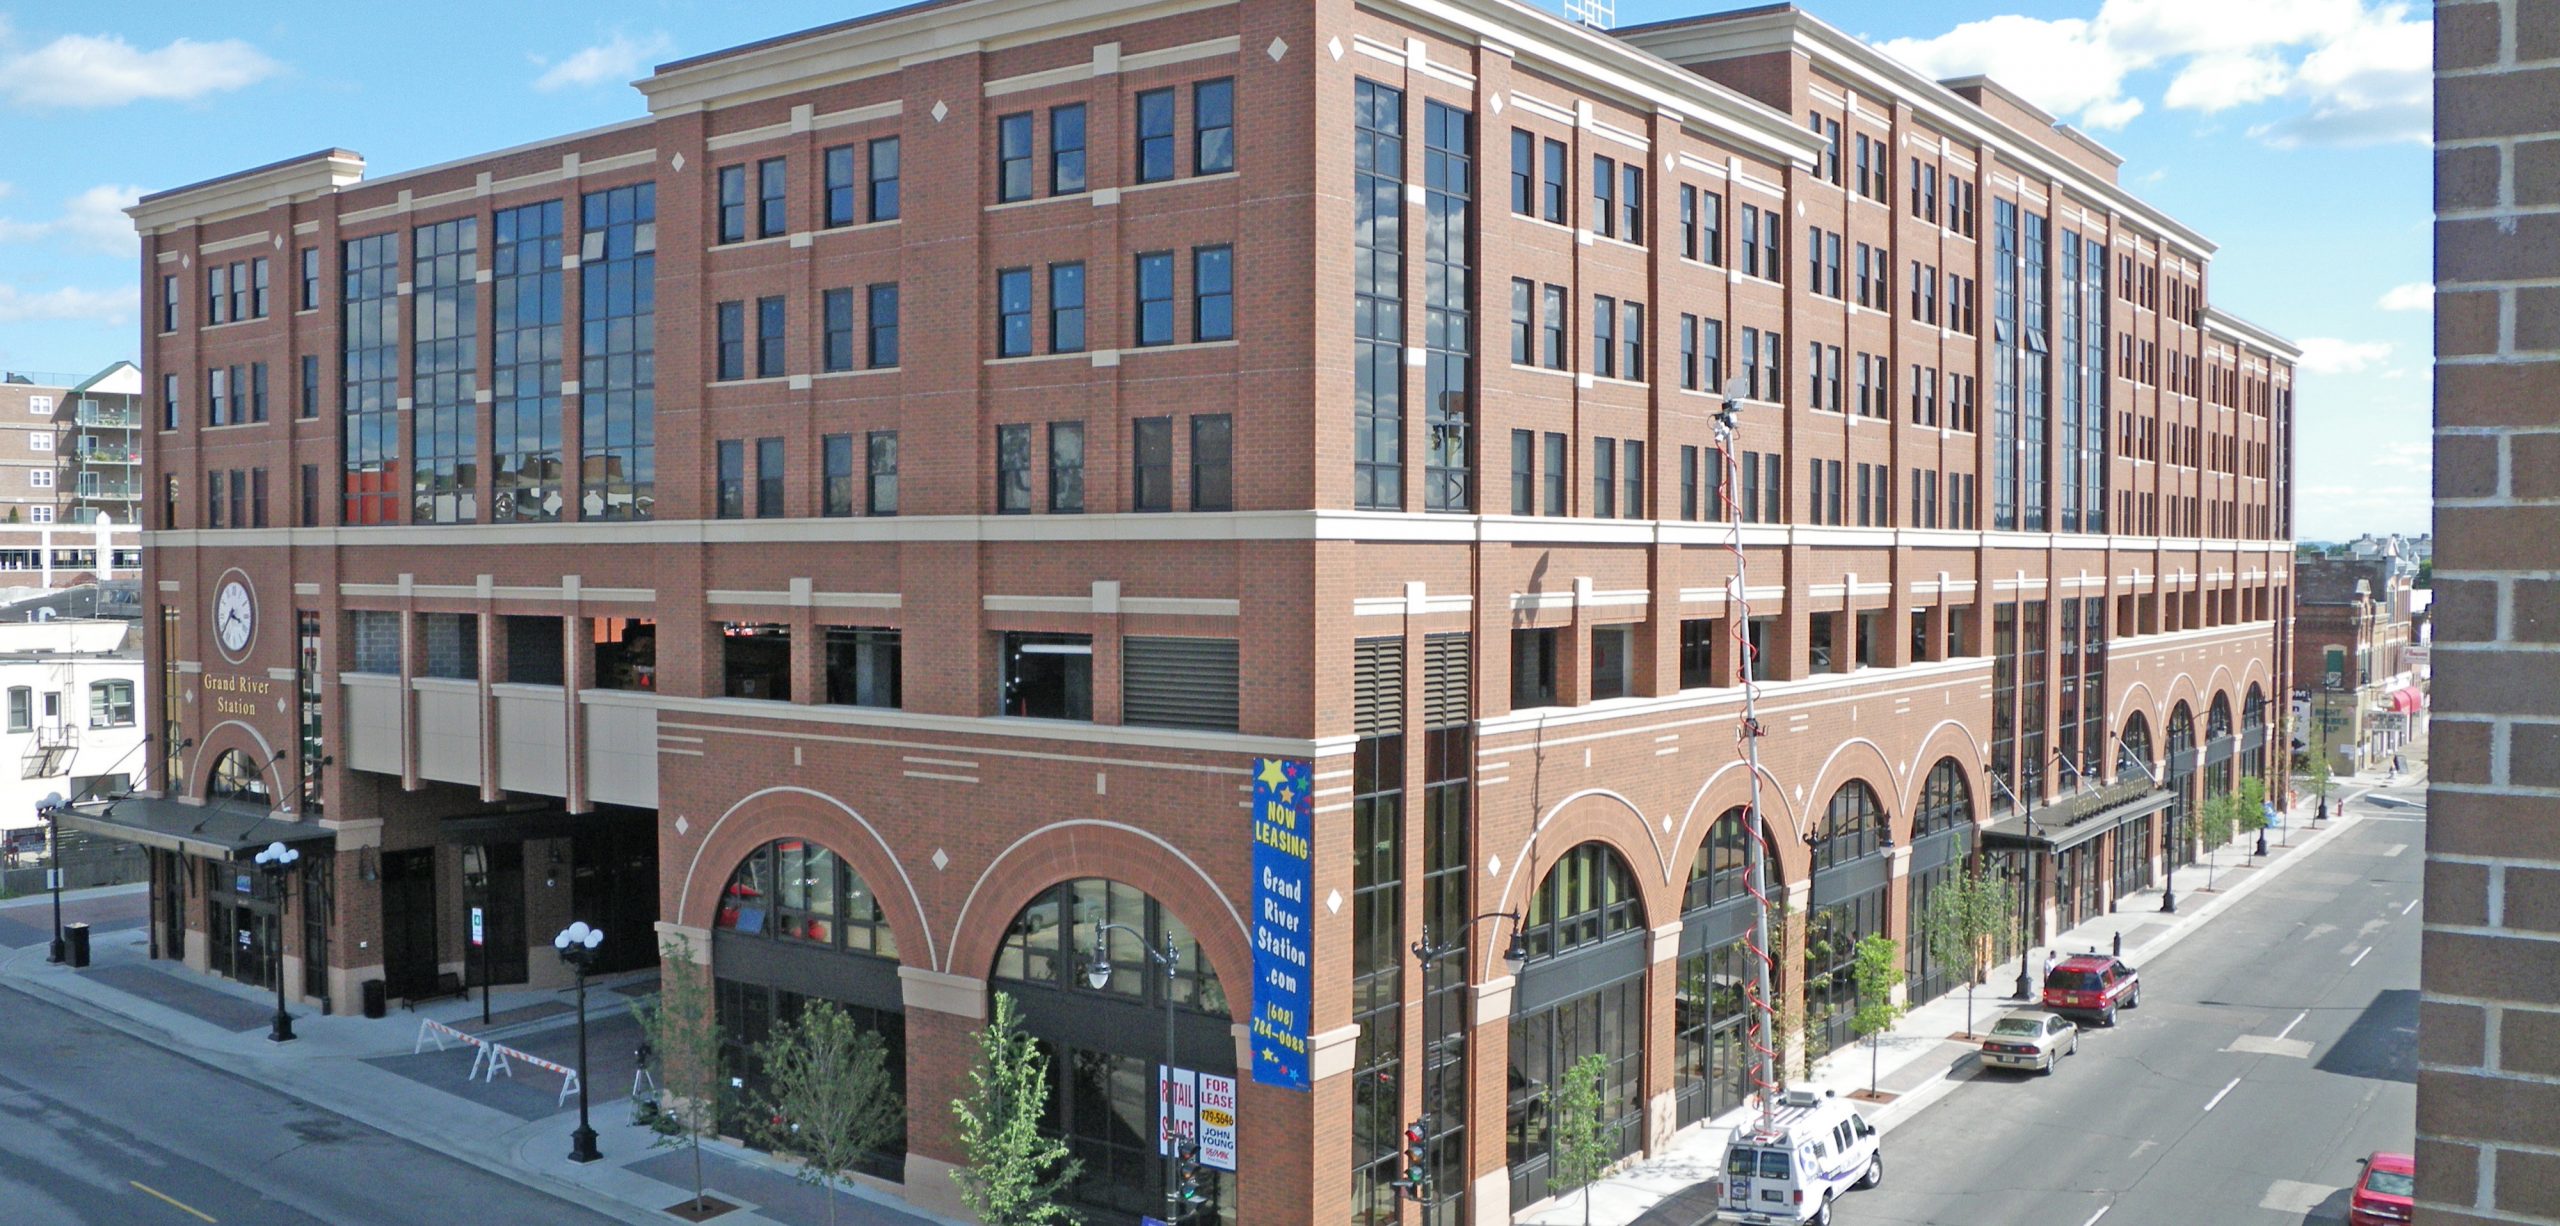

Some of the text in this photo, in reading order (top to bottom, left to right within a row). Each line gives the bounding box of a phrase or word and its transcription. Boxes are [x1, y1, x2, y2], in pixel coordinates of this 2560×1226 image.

[204, 674, 269, 694] Grand River
[218, 697, 255, 715] Station
[1268, 801, 1296, 830] NOW
[1256, 821, 1308, 860] LEASING
[1263, 866, 1301, 903] Grand
[1265, 898, 1299, 933] River
[1258, 926, 1305, 967] Station
[1266, 967, 1297, 993] .com
[1267, 1001, 1293, 1031] (608)
[1254, 1017, 1305, 1054] 784-0088
[1162, 1080, 1193, 1108] RTAIL
[1206, 1078, 1229, 1093] FOR
[1201, 1092, 1233, 1109] LEASE
[1162, 1116, 1193, 1141] SACE
[1201, 1110, 1233, 1126] 779-5646
[1202, 1137, 1233, 1150] YOUNG
[1205, 1128, 1230, 1139] JOHN
